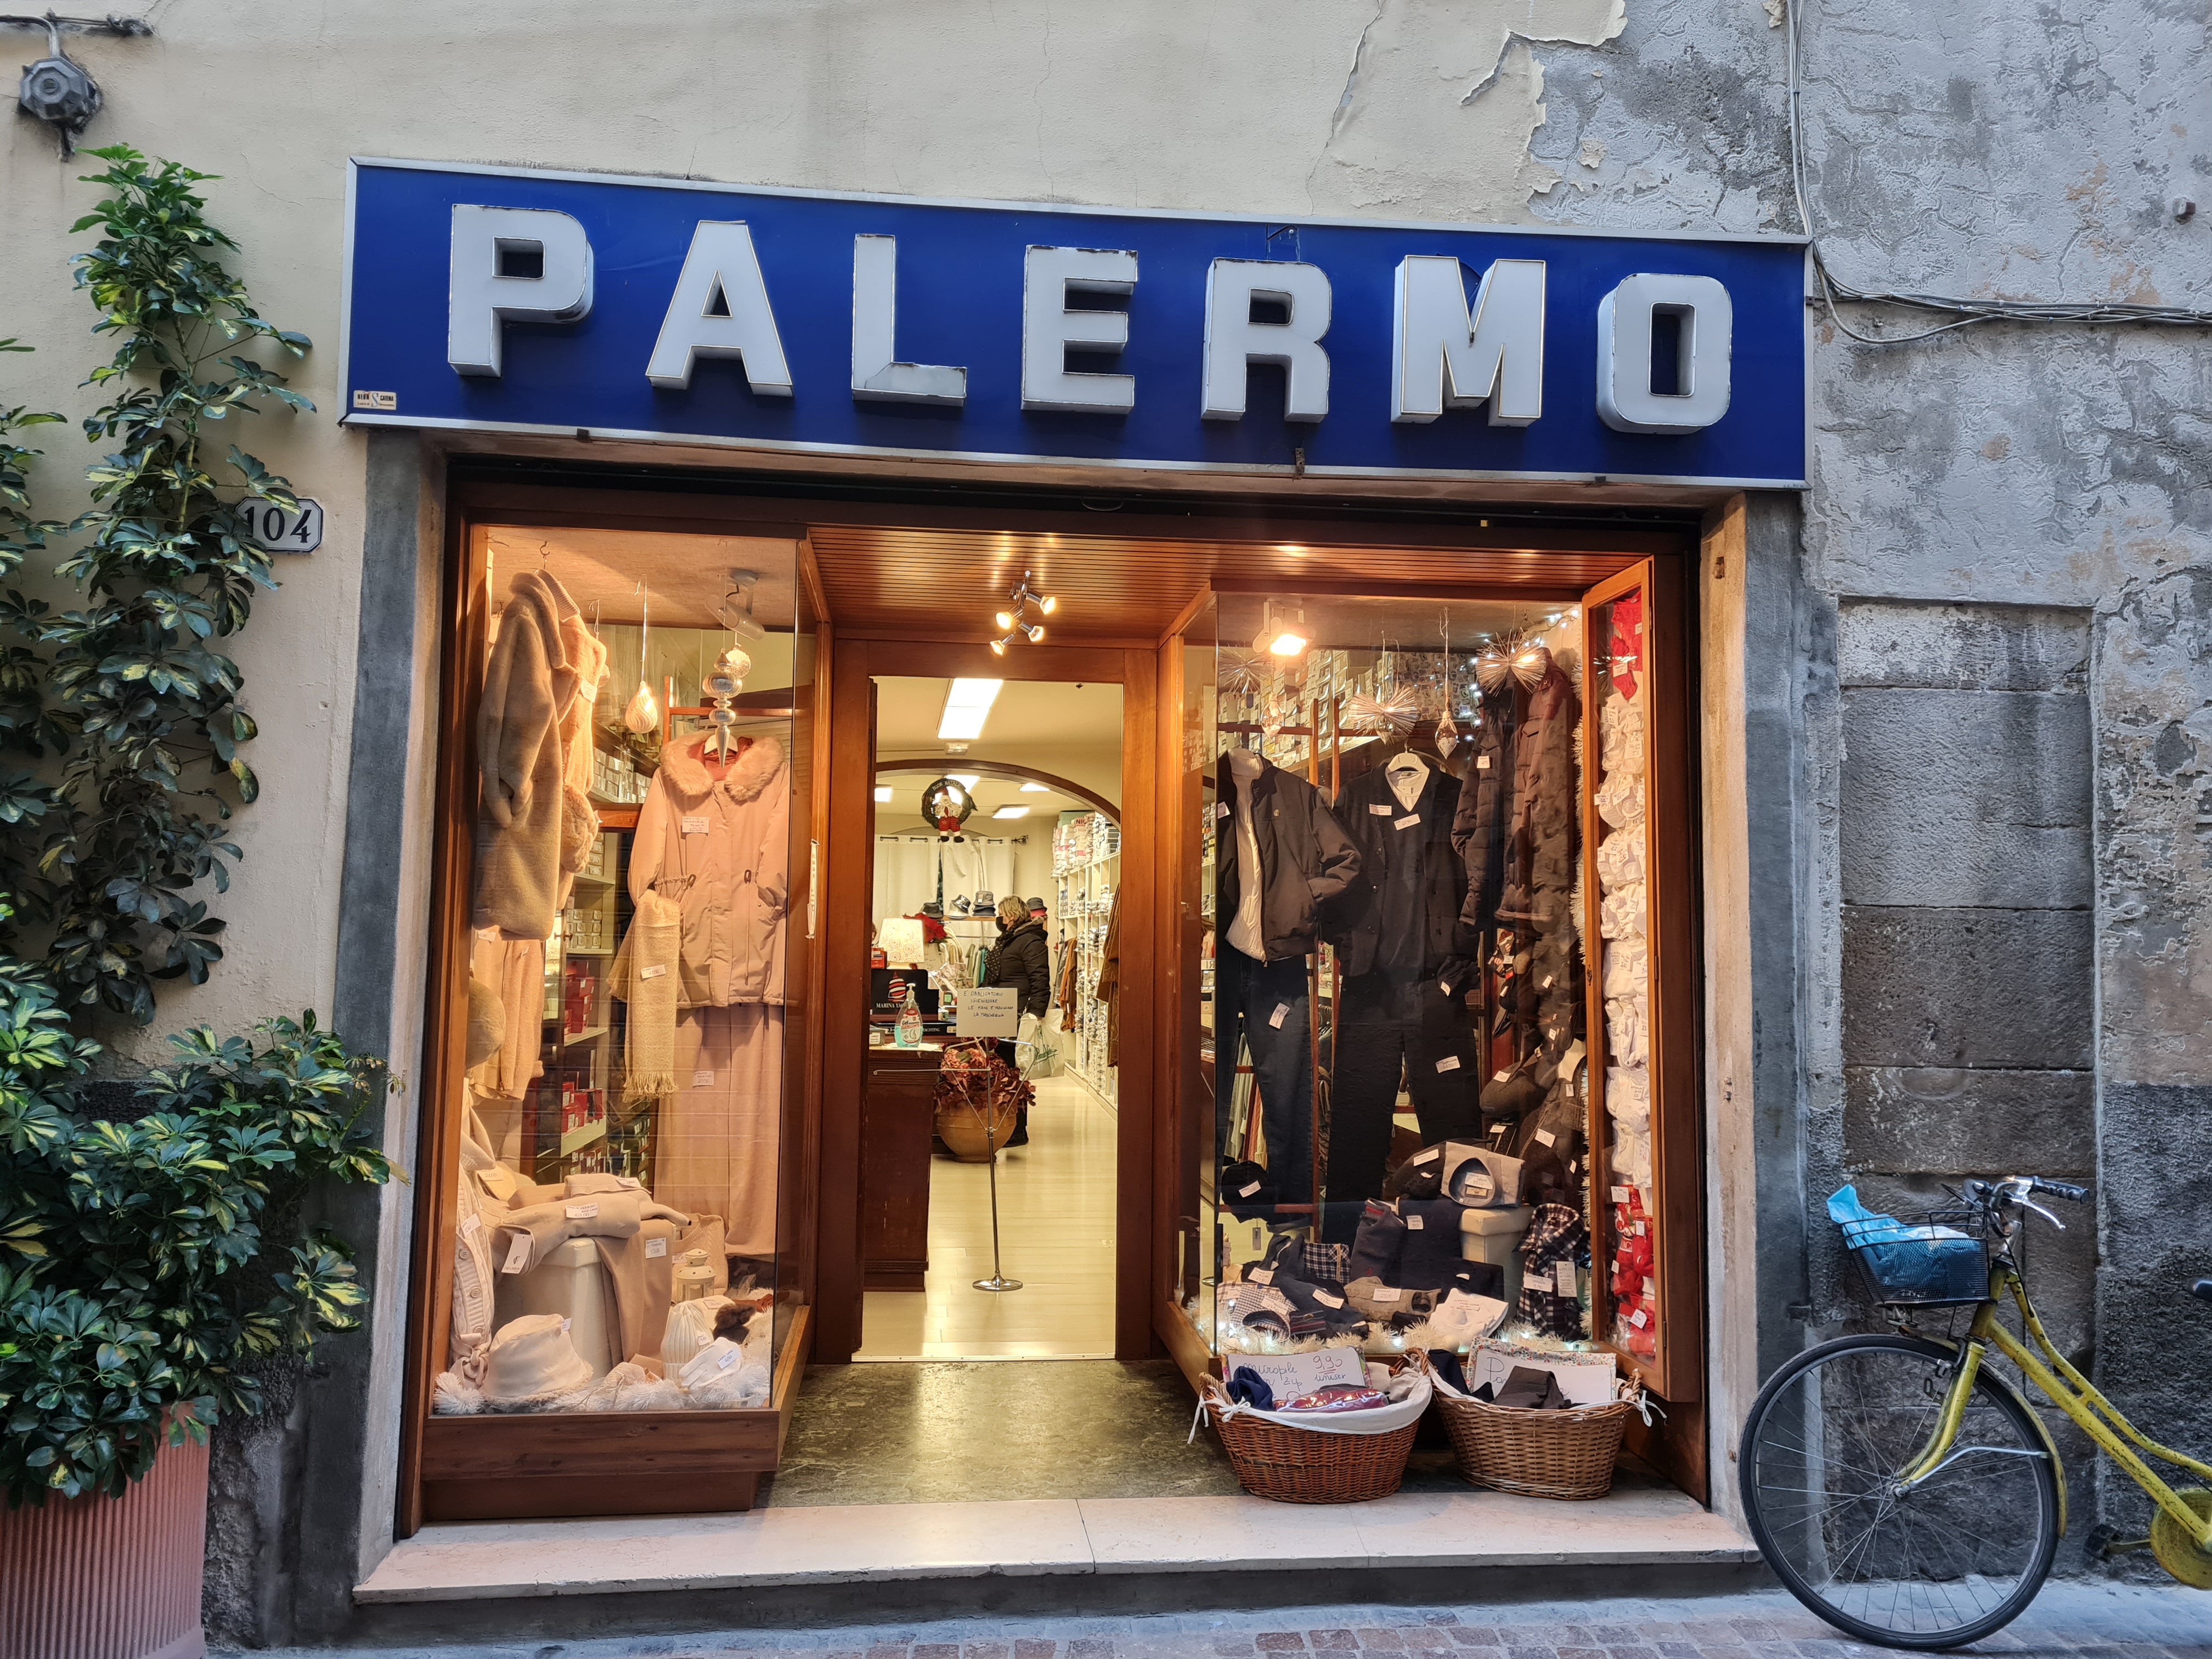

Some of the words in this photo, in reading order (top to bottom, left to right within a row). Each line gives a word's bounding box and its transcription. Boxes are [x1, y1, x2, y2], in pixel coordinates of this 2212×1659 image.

[448, 204, 1733, 434] PALERMO
[245, 506, 312, 543] 104
[932, 781, 943, 791] BUON
